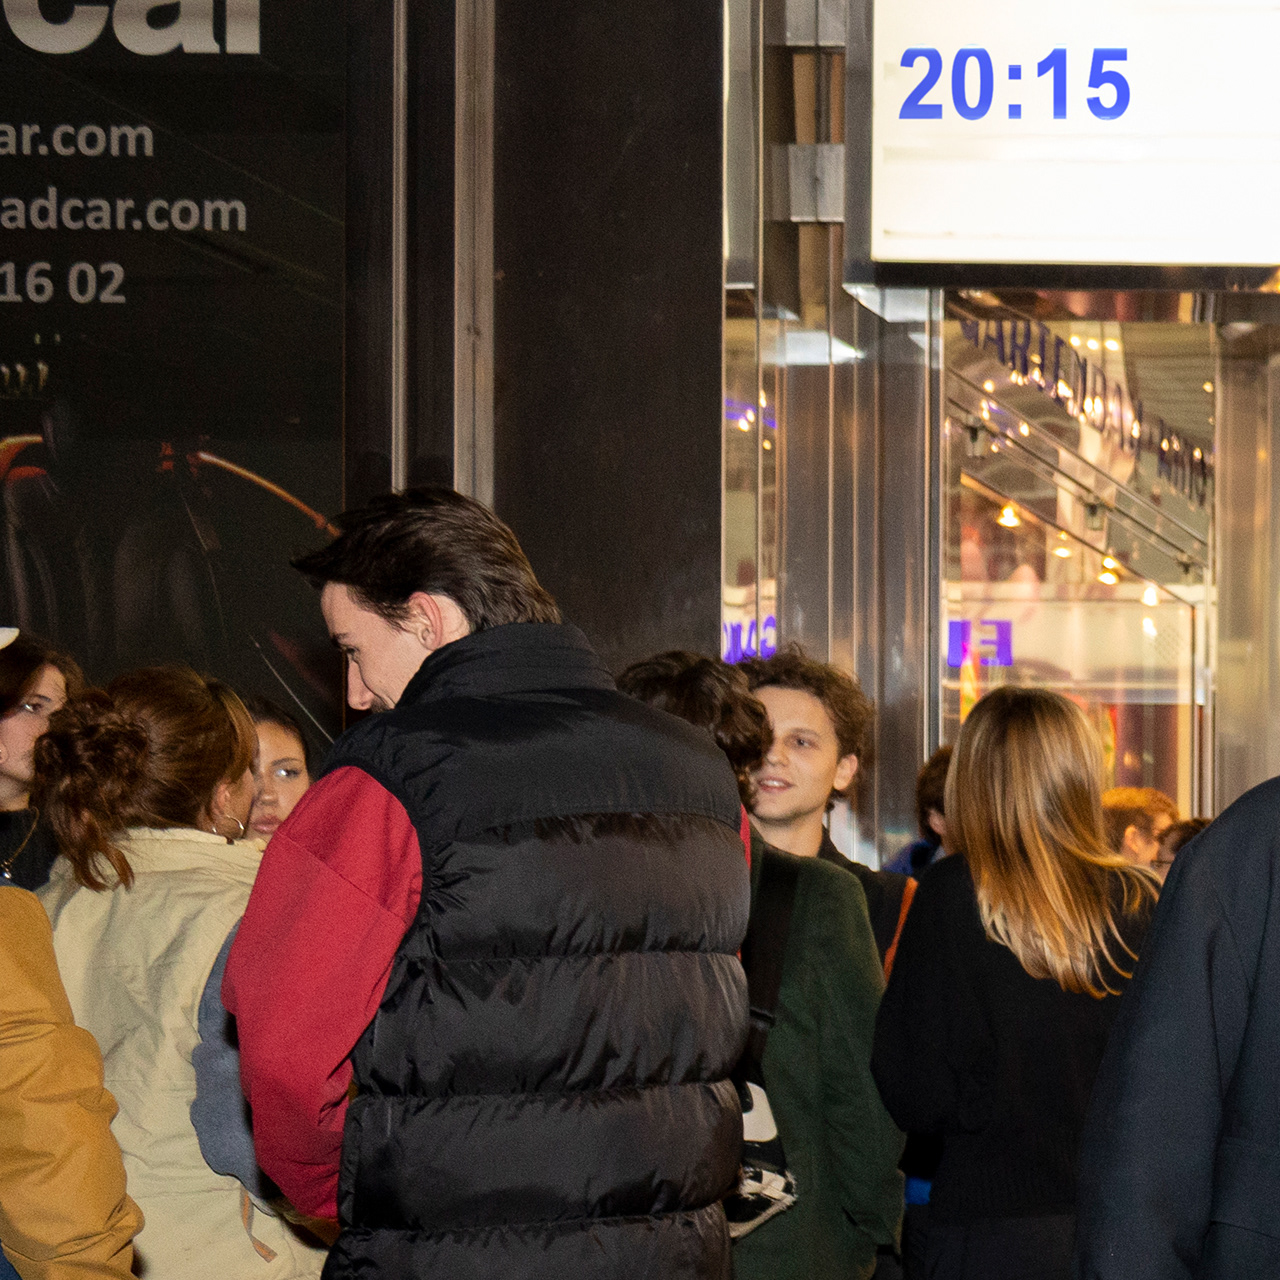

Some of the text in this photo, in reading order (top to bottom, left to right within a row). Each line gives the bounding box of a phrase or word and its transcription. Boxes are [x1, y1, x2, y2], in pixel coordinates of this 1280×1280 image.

[898, 46, 1131, 121] 20:15
[1, 185, 248, 232] adcar.com
[0, 261, 126, 304] 16 02
